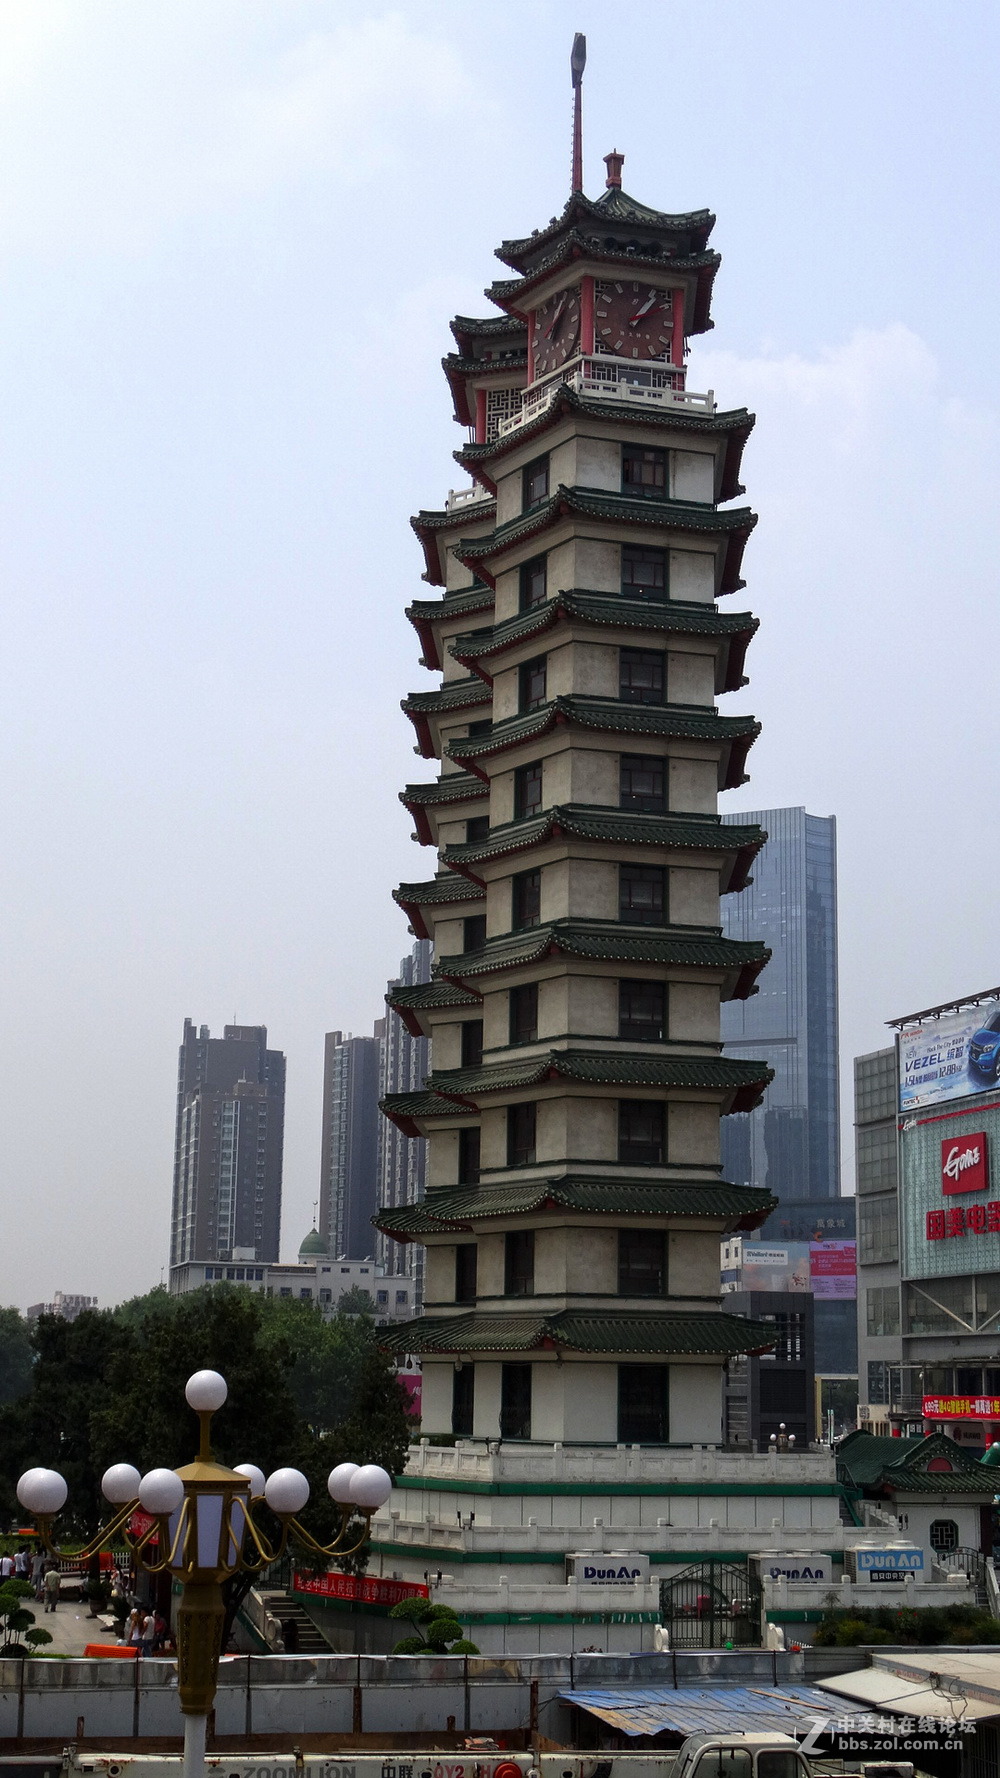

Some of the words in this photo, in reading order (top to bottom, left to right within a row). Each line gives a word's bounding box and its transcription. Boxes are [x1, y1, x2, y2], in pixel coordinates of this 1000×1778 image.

[905, 1053, 944, 1073] VEZEL
[925, 1200, 1000, 1241] 国美电器
[583, 1567, 641, 1579] DunAn
[769, 1566, 823, 1579] DunAn
